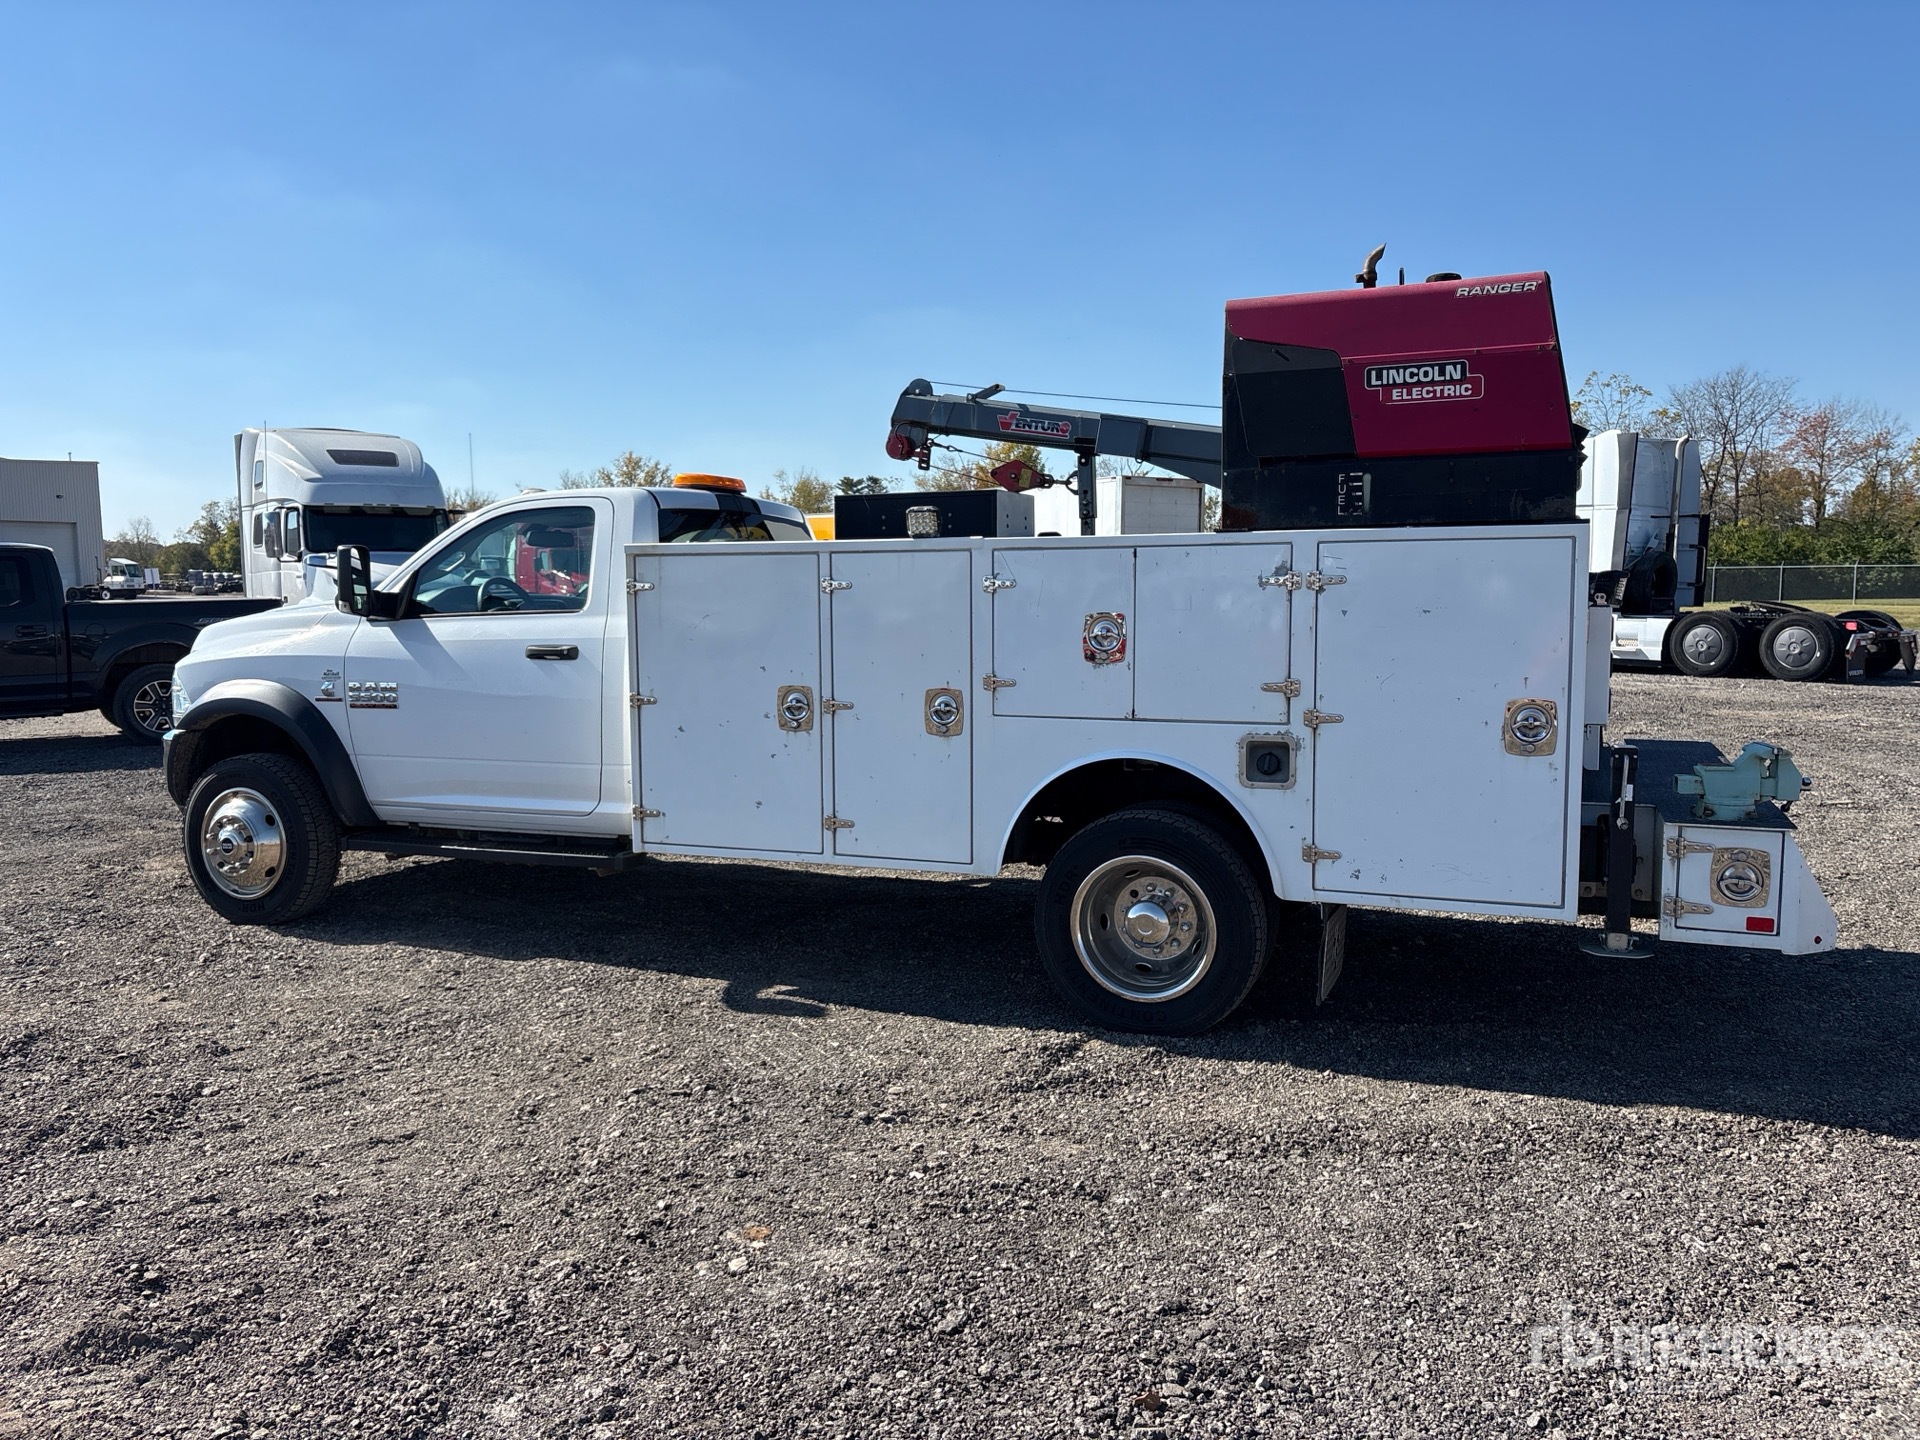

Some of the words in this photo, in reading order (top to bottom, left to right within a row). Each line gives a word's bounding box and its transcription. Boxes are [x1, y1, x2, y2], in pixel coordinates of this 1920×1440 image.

[1455, 281, 1538, 298] RANGER
[1370, 364, 1462, 386] LINCOLN
[1392, 383, 1473, 401] ELECTRIC
[1337, 474, 1347, 516] FUEL
[348, 681, 398, 692] RAM
[348, 692, 398, 703] 5500
